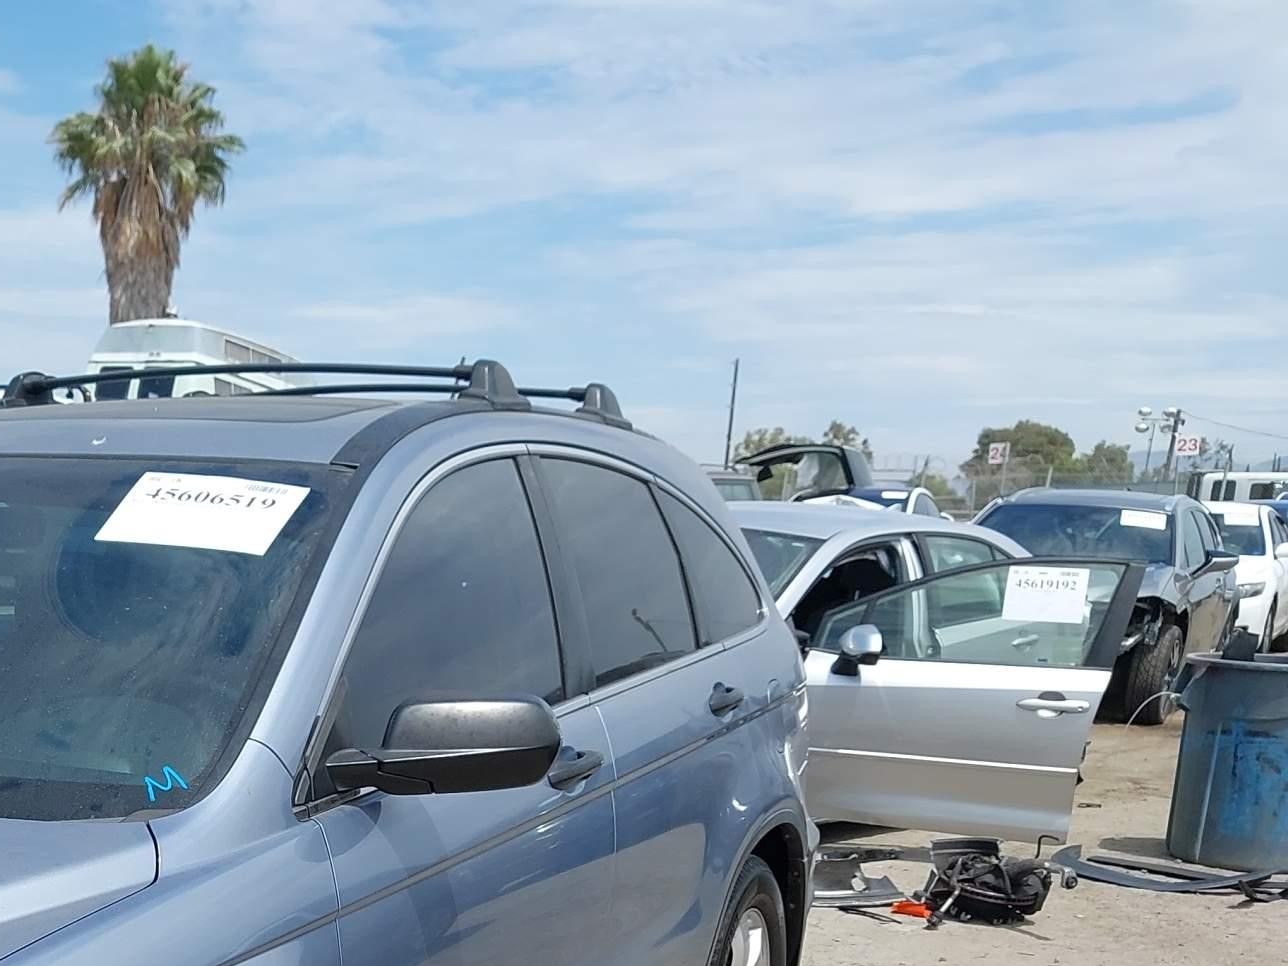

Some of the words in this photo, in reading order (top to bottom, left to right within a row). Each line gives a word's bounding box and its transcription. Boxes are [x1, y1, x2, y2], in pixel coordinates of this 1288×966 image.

[1177, 438, 1198, 452] 23
[146, 487, 276, 509] 45606519
[1016, 579, 1077, 591] 45619192
